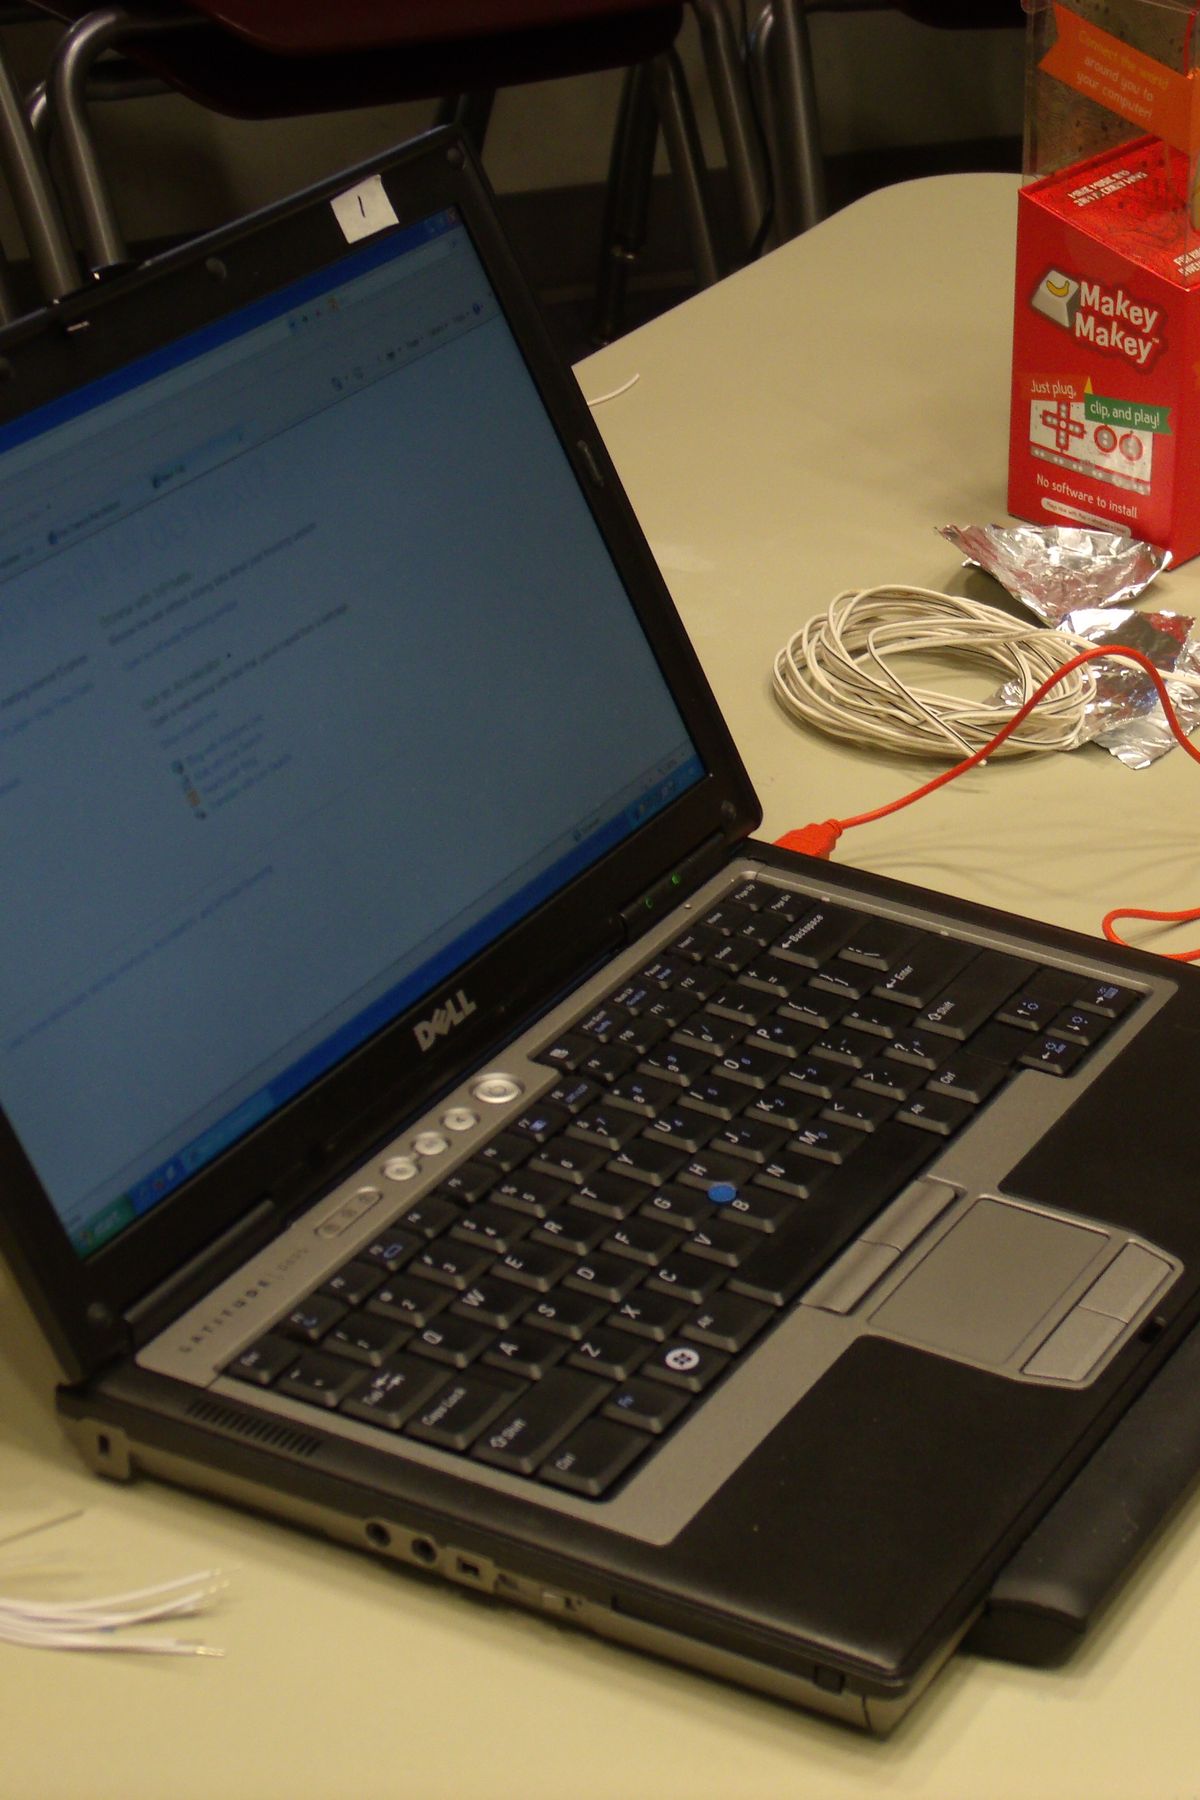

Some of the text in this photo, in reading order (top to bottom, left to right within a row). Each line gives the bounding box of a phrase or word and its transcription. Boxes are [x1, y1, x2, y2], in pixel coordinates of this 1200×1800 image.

[1075, 70, 1100, 91] your
[1083, 56, 1120, 82] around
[1142, 86, 1154, 103] to
[1080, 280, 1159, 334] Makey
[1075, 311, 1153, 365] Makey
[1030, 380, 1051, 394] Just
[1112, 407, 1133, 421] and
[1134, 408, 1161, 430] play!
[1036, 473, 1050, 488] No
[1051, 482, 1095, 504] software
[1096, 496, 1107, 509] to
[1109, 500, 1138, 519] install
[788, 913, 825, 943] Backspace
[412, 988, 477, 1053] DELL
[756, 1028, 771, 1040] P
[755, 1099, 775, 1112] K
[653, 1119, 672, 1133] U
[723, 1131, 740, 1144] J
[798, 1129, 820, 1145] M
[616, 1153, 635, 1166] Y
[688, 1162, 708, 1177] H
[765, 1163, 787, 1178] N
[580, 1186, 598, 1200] T
[652, 1196, 672, 1210] G
[731, 1199, 750, 1212] B
[543, 1219, 564, 1235] R
[613, 1231, 631, 1246] F
[503, 1254, 524, 1270] E
[575, 1265, 596, 1281] D
[658, 1267, 678, 1283] C
[461, 1287, 486, 1307] W
[537, 1303, 557, 1319] S
[619, 1303, 642, 1320] X
[498, 1341, 520, 1357] A
[579, 1341, 602, 1358] Z
